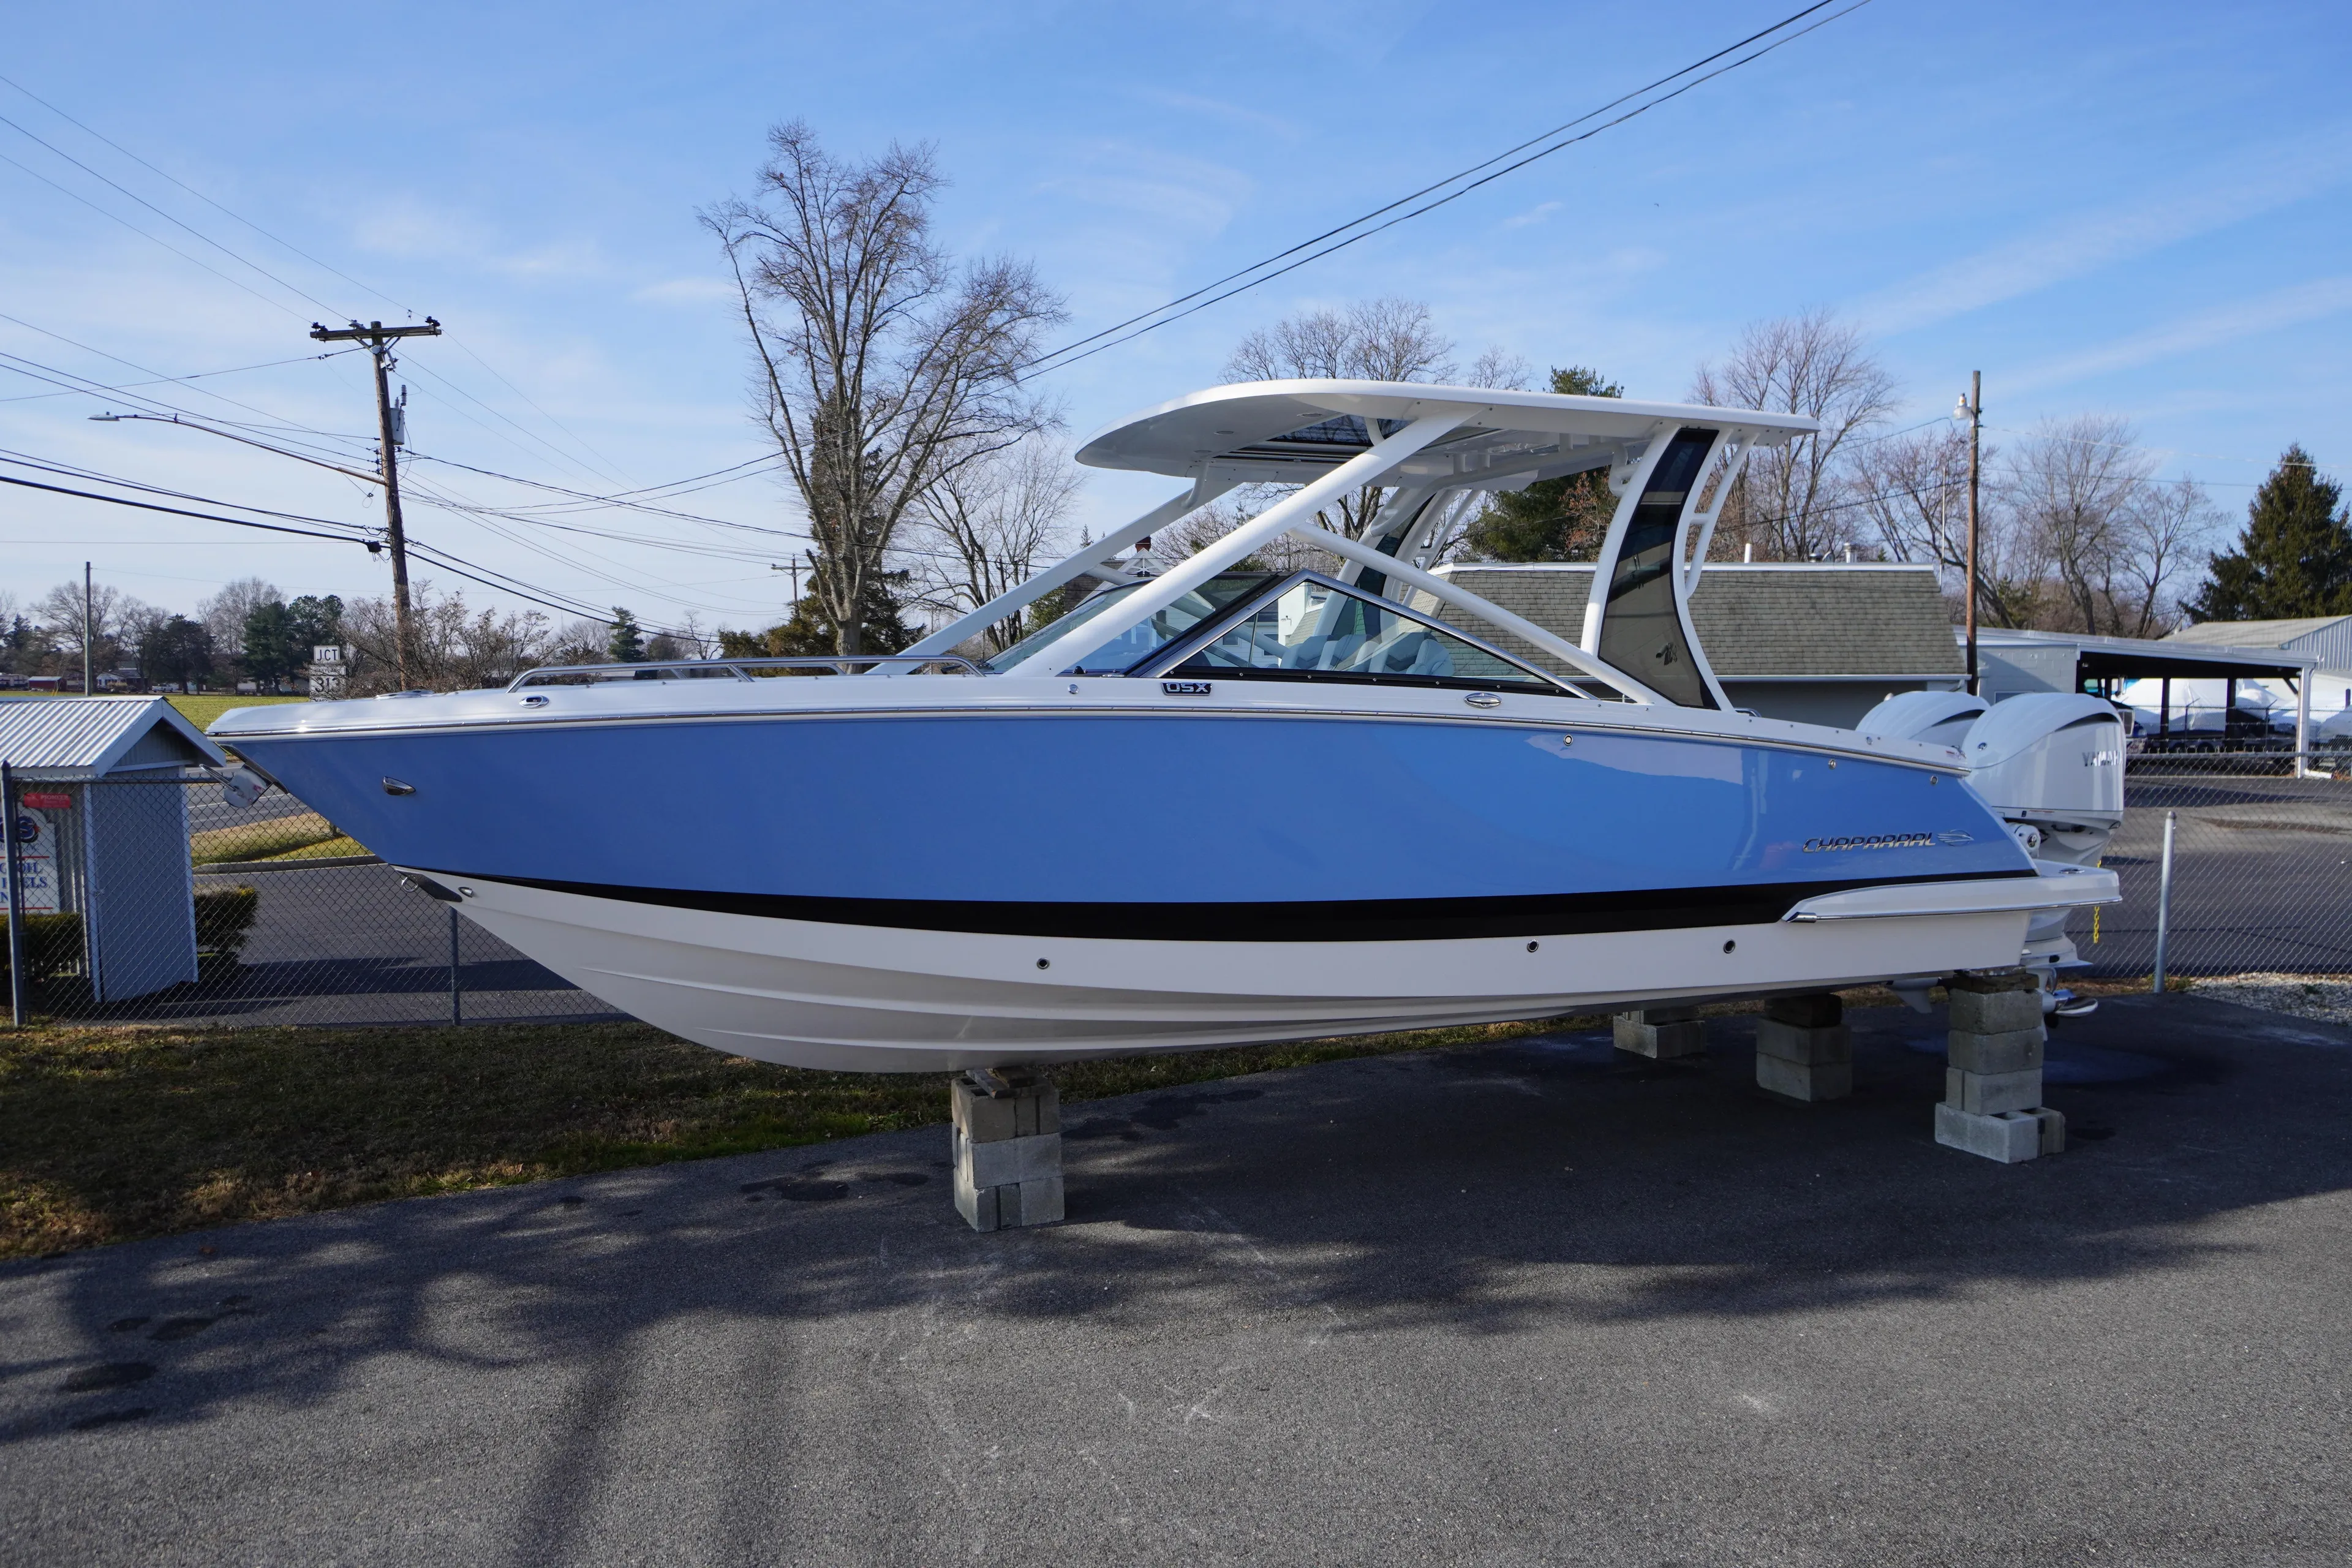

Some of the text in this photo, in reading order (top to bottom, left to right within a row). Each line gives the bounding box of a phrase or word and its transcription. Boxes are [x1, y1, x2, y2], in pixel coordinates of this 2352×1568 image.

[317, 649, 337, 661] JCT
[1166, 682, 1209, 692] OSX
[1803, 832, 1936, 853] CHAPARRAL
